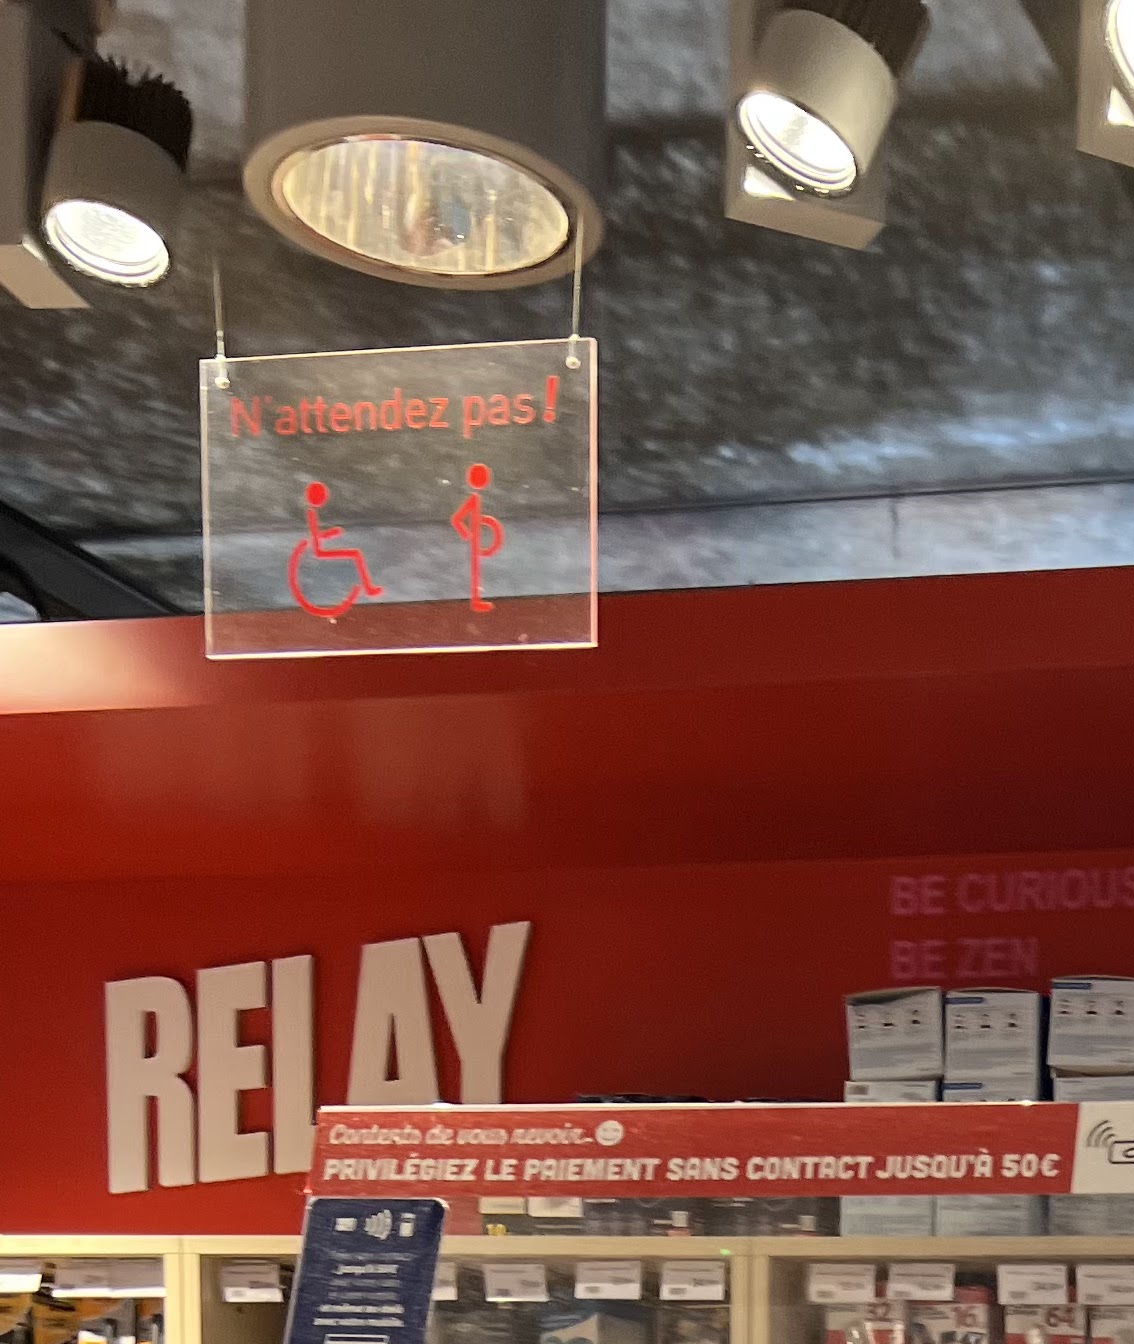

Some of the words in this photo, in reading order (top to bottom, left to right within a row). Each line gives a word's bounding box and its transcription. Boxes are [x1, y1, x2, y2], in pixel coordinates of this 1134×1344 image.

[230, 387, 449, 438] N'attendez
[889, 875, 947, 918] BE
[889, 940, 947, 980] BE
[956, 936, 1040, 978] ZEN
[426, 1123, 455, 1145] de
[458, 1128, 508, 1145] vous
[323, 1153, 480, 1182] PRIVILÉGIEZ
[483, 1159, 519, 1182] LE
[523, 1157, 663, 1182] PAIEMENT
[666, 1156, 740, 1181] SANS
[745, 1155, 875, 1181] CONTACT
[875, 1148, 993, 1179] JUSQU'À
[1001, 1153, 1062, 1179] 50€
